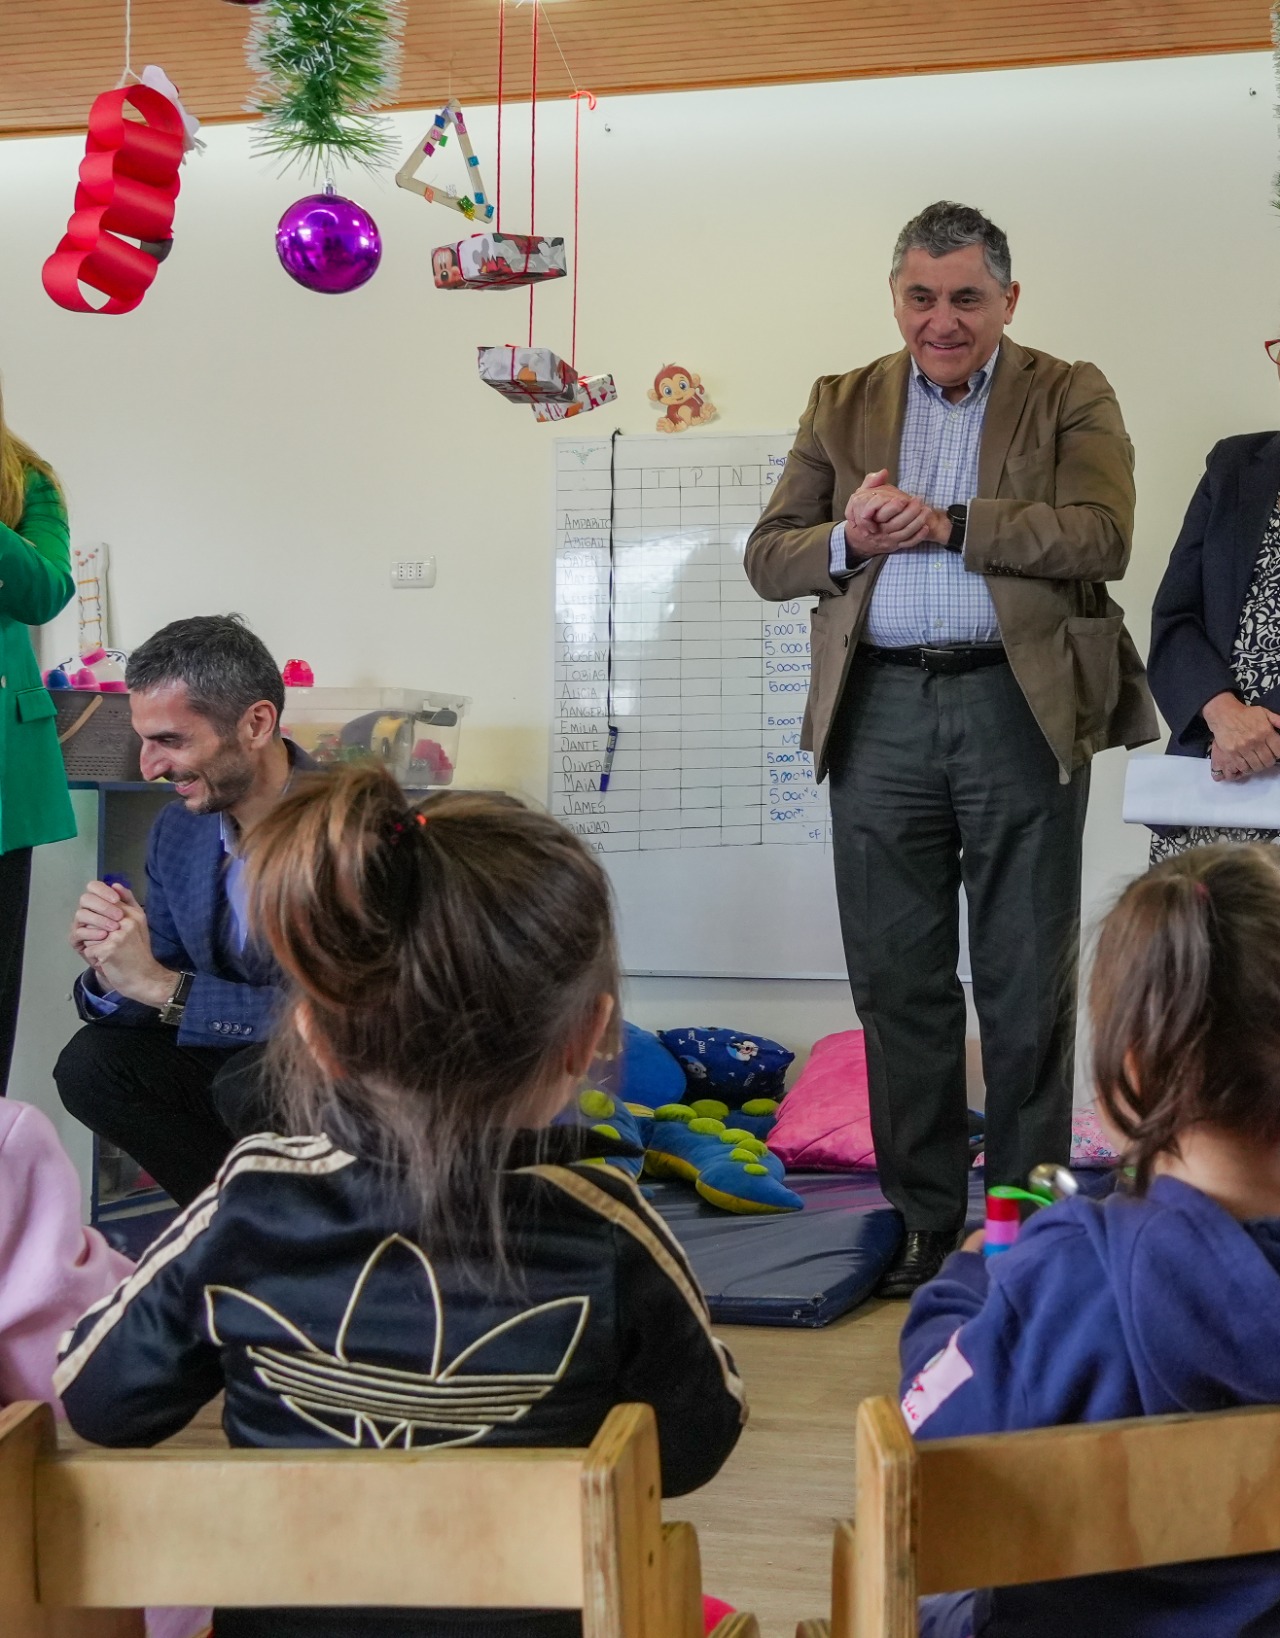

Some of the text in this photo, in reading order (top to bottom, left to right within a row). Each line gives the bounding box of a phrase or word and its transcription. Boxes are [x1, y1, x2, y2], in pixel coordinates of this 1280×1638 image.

[651, 470, 665, 488] T
[690, 467, 703, 487] P
[732, 467, 743, 486] N
[777, 601, 801, 618] NO
[764, 640, 803, 656] 5.000
[561, 793, 606, 815] JAMES
